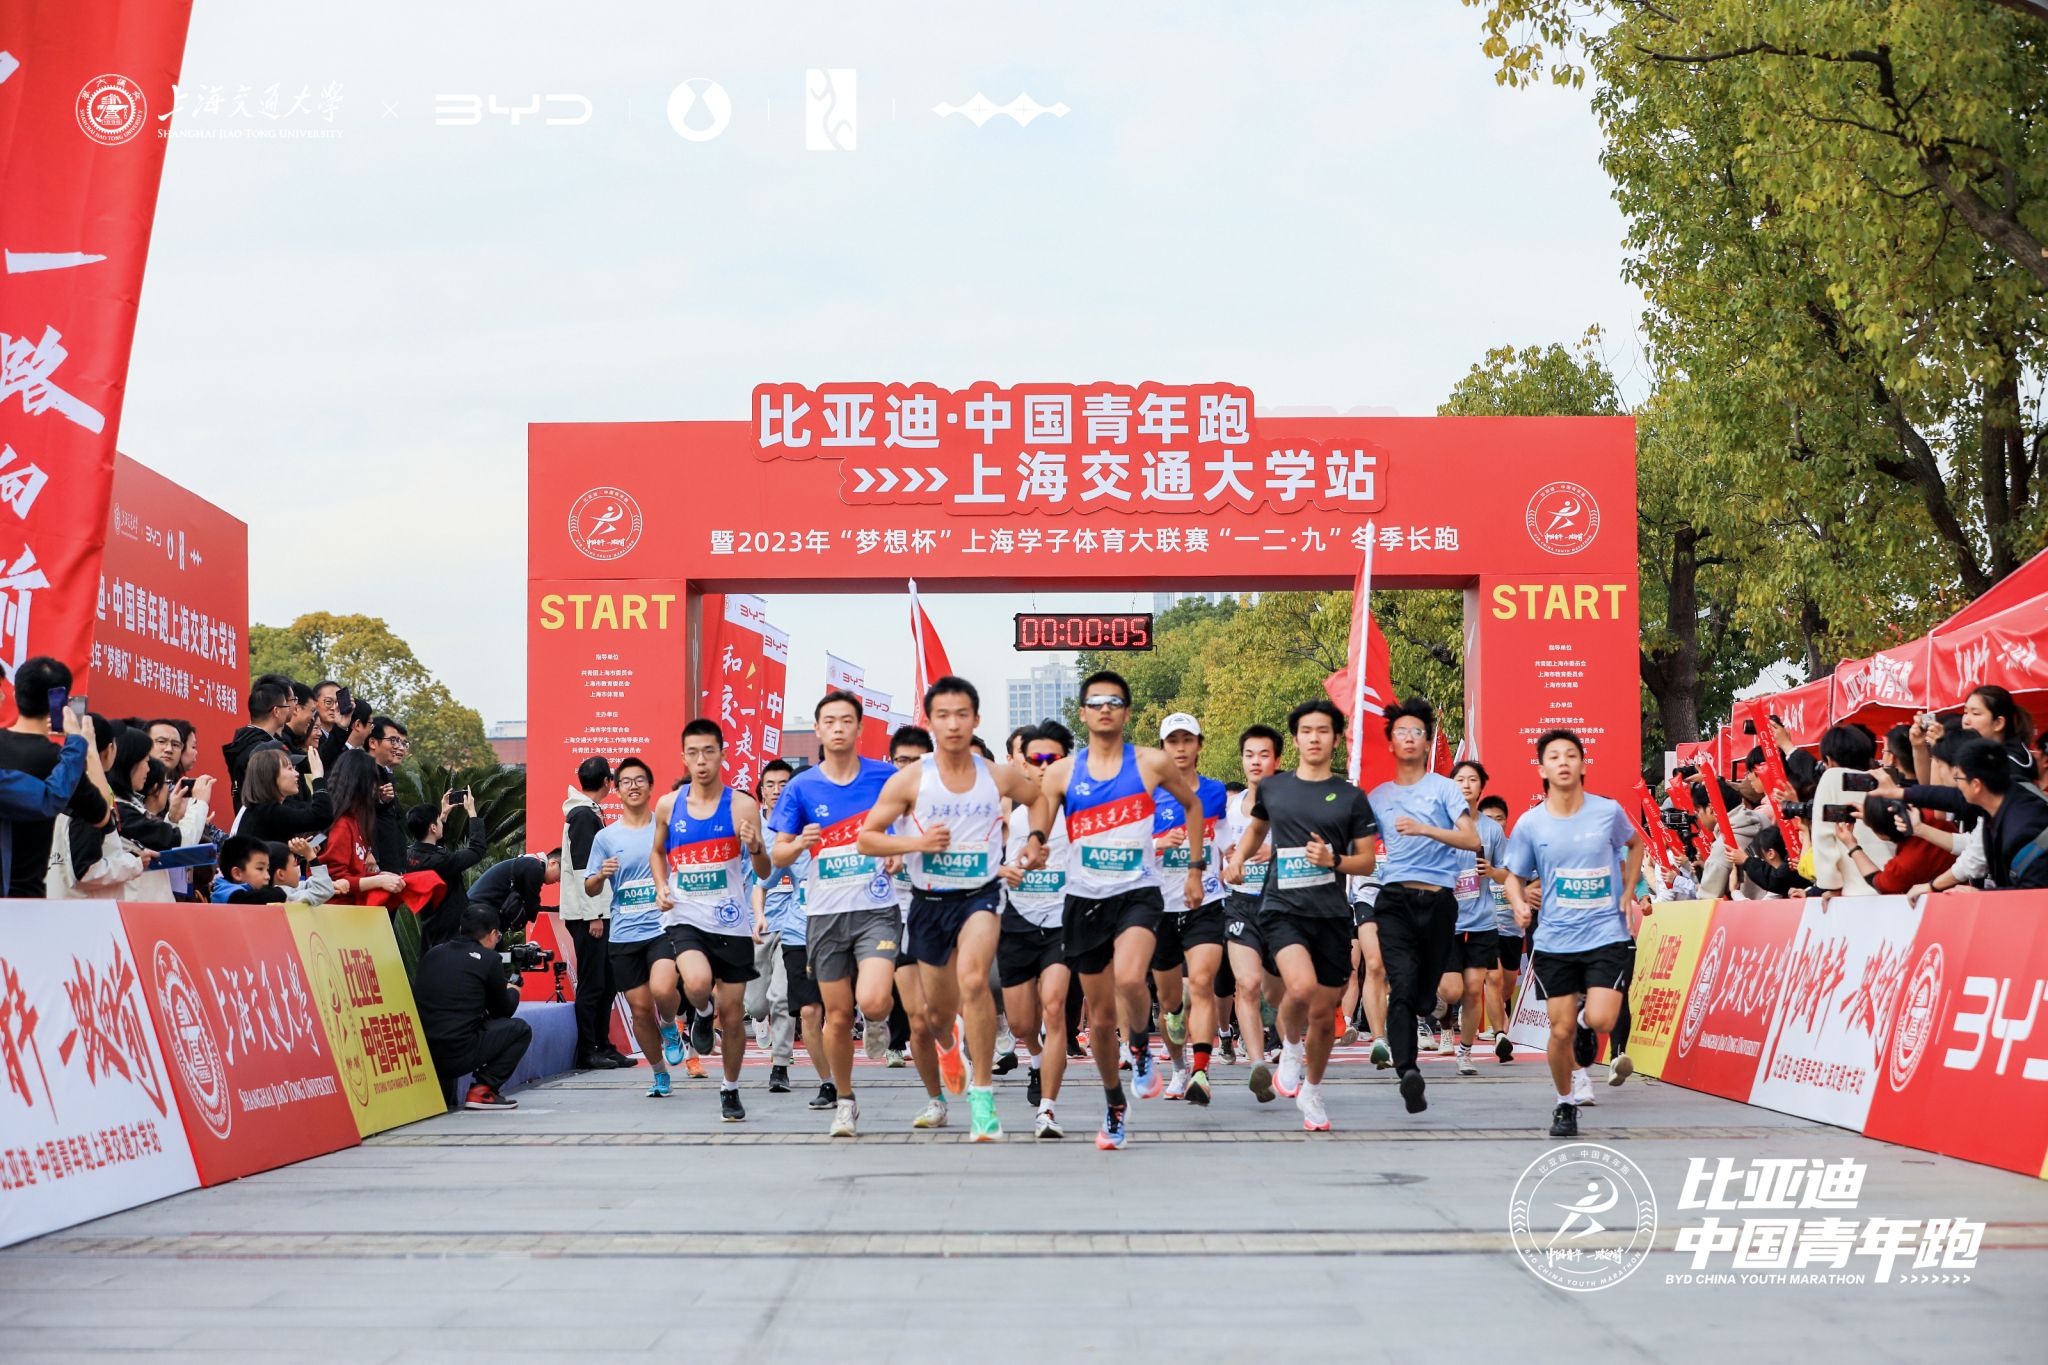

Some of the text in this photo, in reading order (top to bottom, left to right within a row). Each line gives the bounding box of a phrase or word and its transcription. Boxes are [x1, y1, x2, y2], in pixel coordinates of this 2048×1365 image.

[758, 393, 1251, 449] 比亚迪·中国青年跑
[954, 449, 1378, 504] 上海交通大学站
[541, 594, 676, 630] START
[1492, 584, 1627, 620] START
[1022, 618, 1147, 646] 00:00:05
[825, 854, 866, 871] A0187
[931, 853, 979, 867] A0461
[1089, 849, 1134, 862] A0541
[624, 885, 656, 899] A0447
[682, 871, 718, 885] A0111
[1563, 878, 1605, 891] A0354
[337, 947, 384, 1009] 比亚迪
[360, 1009, 423, 1085] 中国青年跑
